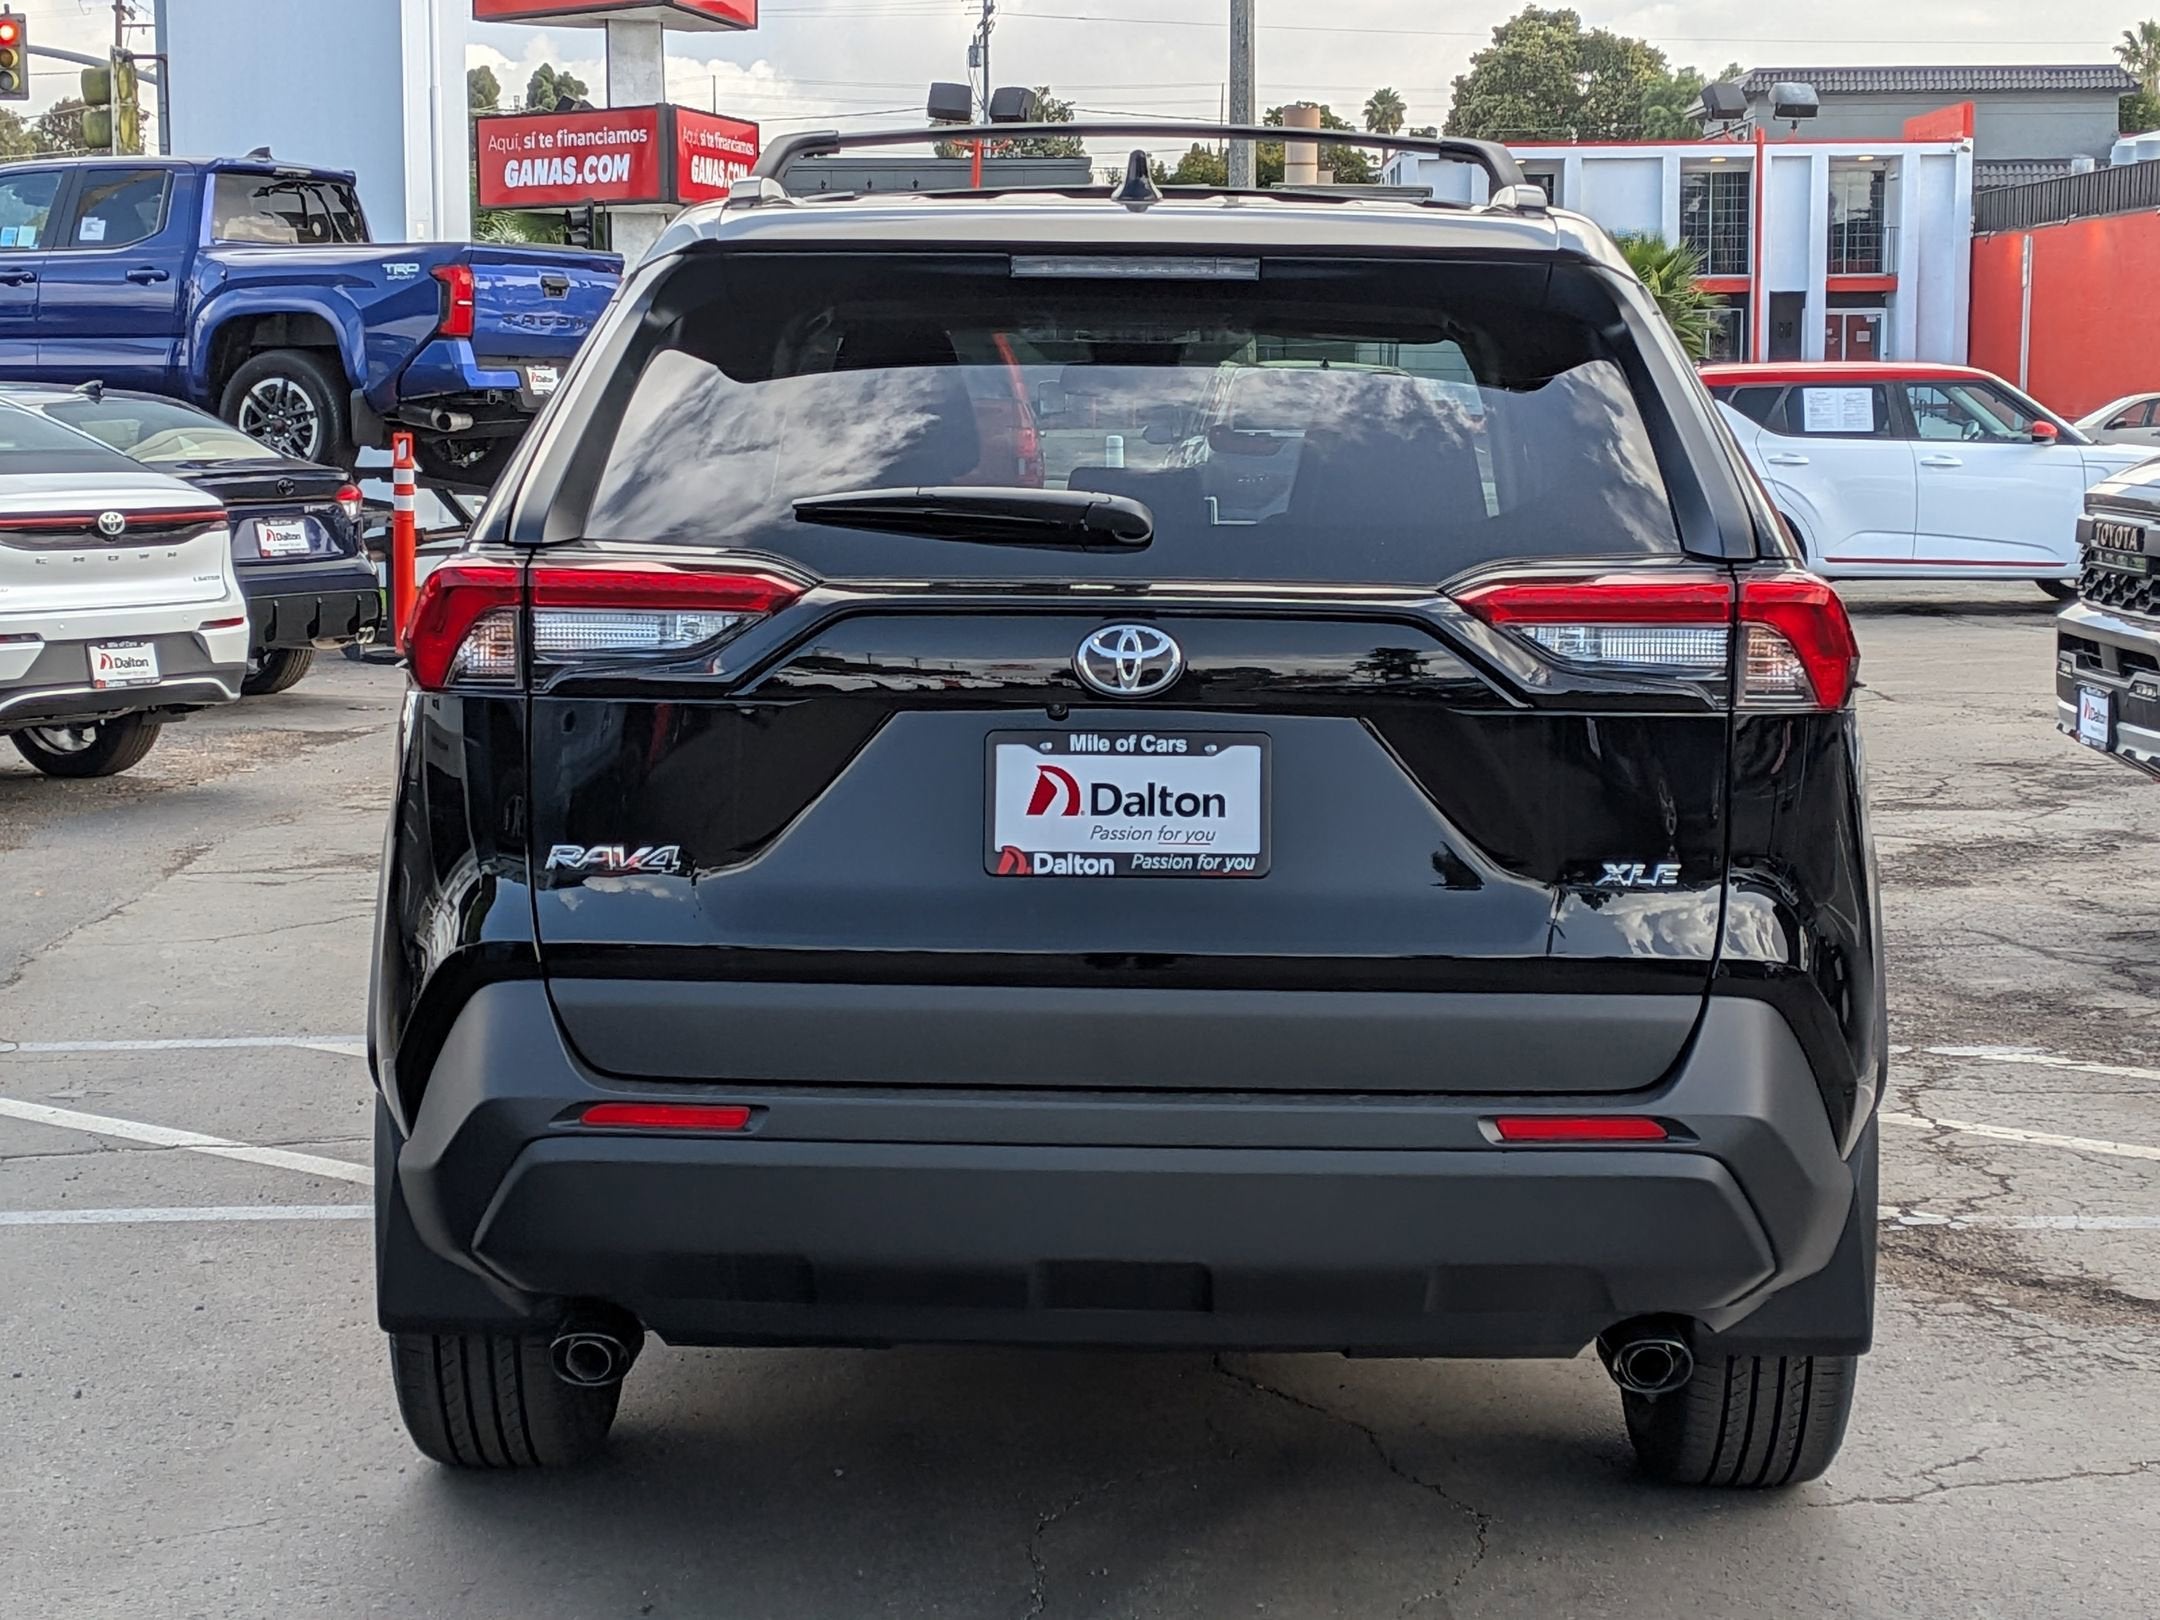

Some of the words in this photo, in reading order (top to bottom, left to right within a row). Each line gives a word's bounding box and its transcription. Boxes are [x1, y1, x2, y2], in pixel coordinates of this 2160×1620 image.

[488, 133, 521, 153] Aquí,
[523, 131, 536, 150] sí
[538, 131, 553, 148] te
[556, 126, 647, 147] financiamos
[504, 154, 632, 189] GANAS.COM
[382, 263, 420, 275] TRD
[2096, 522, 2138, 551] TOYOTA
[114, 657, 149, 669] Dalton
[1069, 734, 1111, 752] Mile
[1115, 734, 1137, 753] of
[1140, 735, 1188, 753] Cars
[1090, 782, 1227, 818] Dalton
[1089, 825, 1153, 841] Passion
[1157, 825, 1182, 842] for
[1184, 828, 1215, 842] you
[545, 844, 681, 873] RAV4
[1033, 853, 1115, 875] Dalton
[1130, 853, 1194, 870] Passion
[1196, 853, 1220, 871] for
[1222, 856, 1256, 874] you
[1594, 864, 1682, 886] XLE
